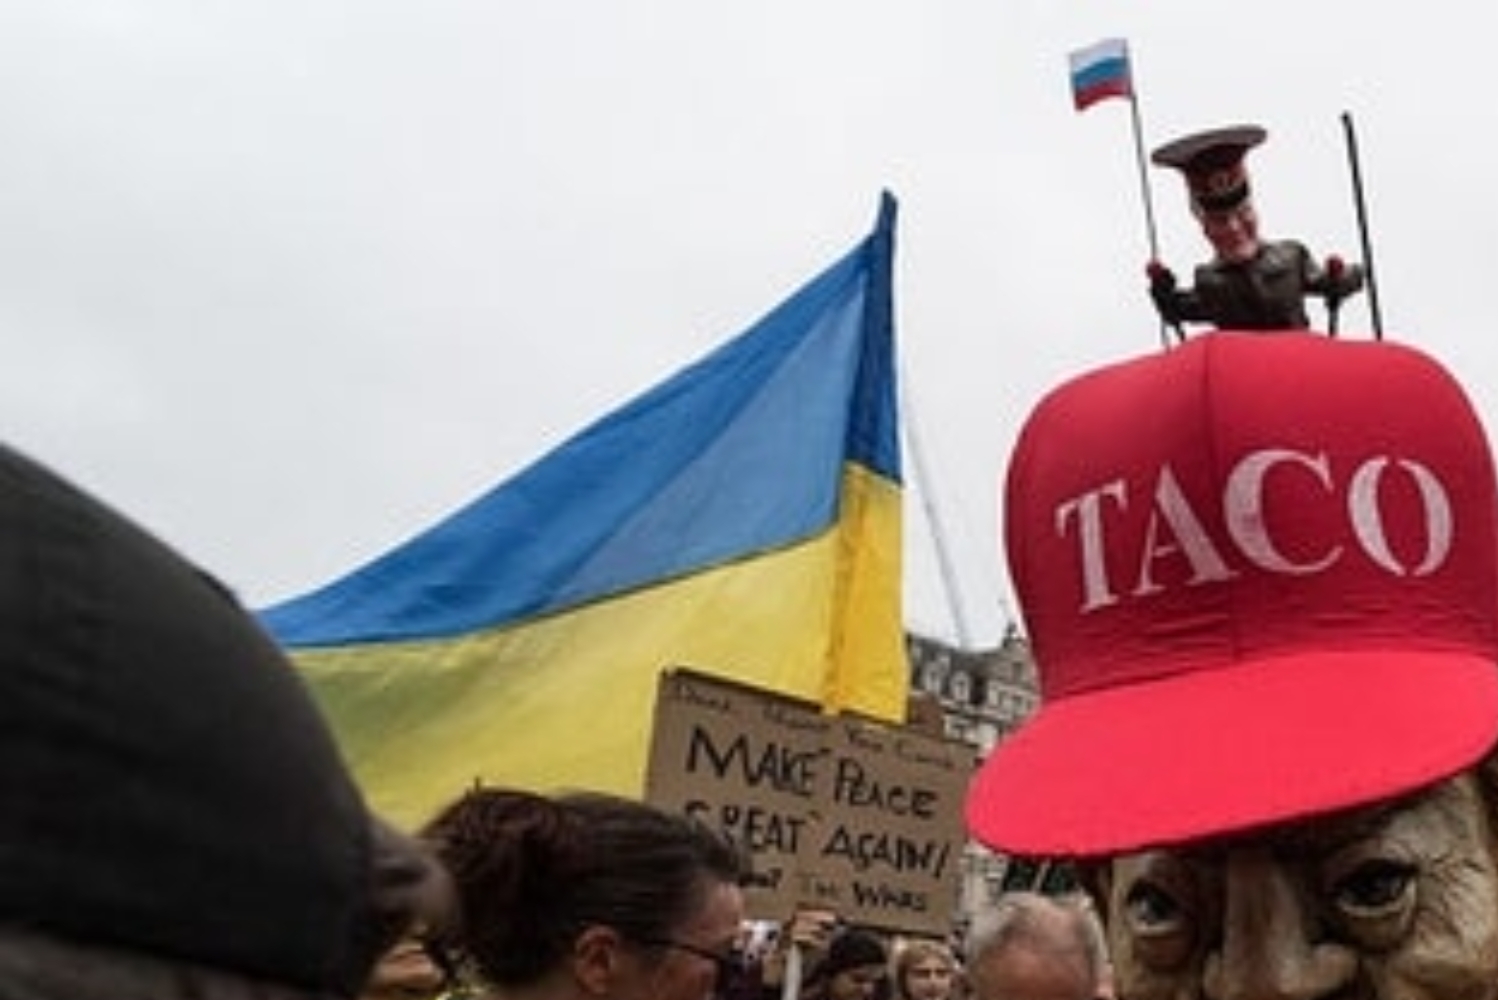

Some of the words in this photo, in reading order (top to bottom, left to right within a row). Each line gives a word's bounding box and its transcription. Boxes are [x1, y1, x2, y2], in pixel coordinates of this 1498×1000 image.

[1054, 448, 1454, 614] TACO
[685, 724, 813, 797] MAKE
[834, 758, 939, 820] PEACE
